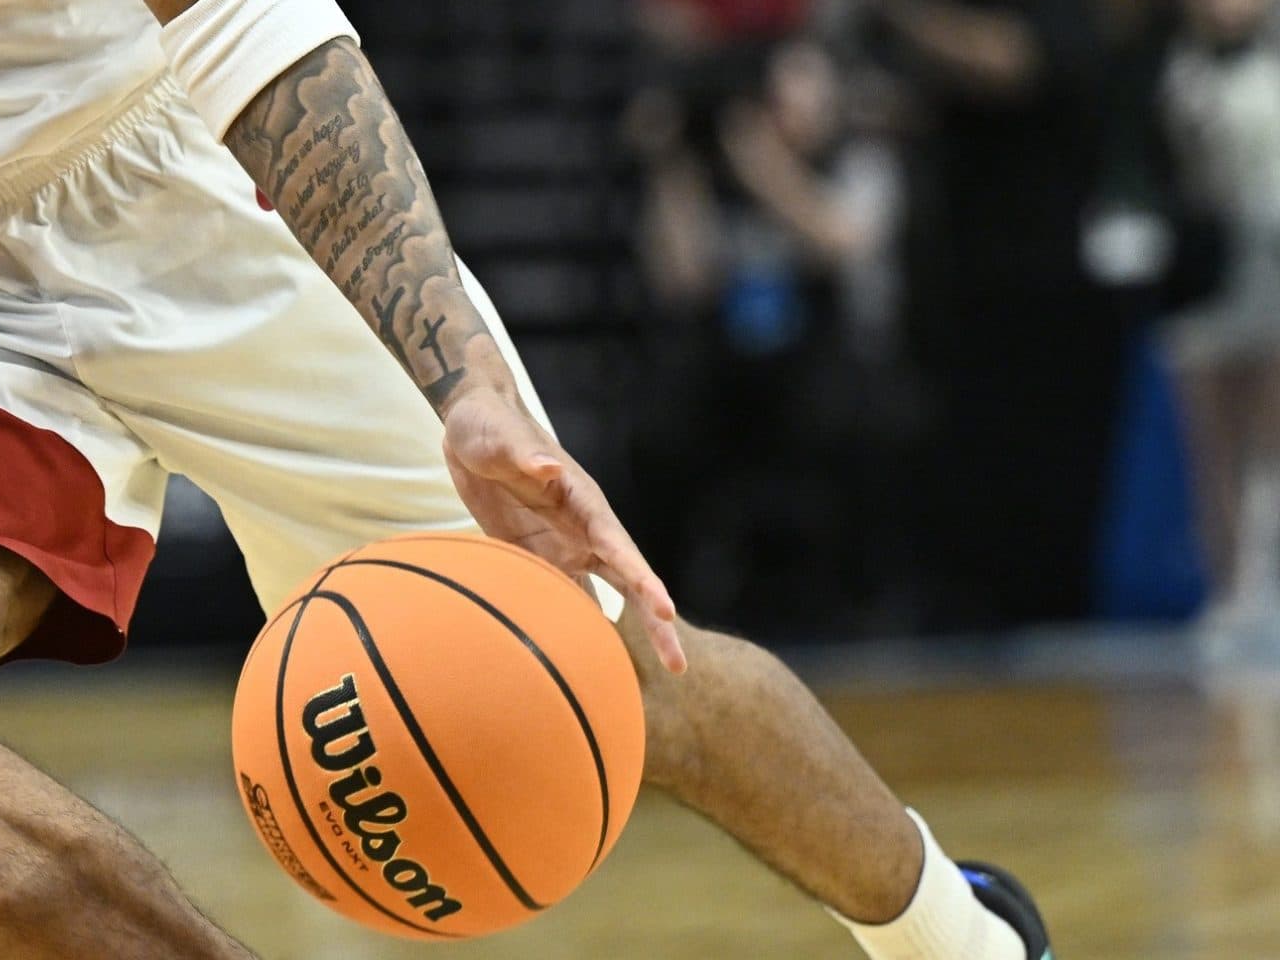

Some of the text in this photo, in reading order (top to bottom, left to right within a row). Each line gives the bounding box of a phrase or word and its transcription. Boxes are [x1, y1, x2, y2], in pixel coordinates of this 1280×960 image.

[301, 672, 463, 923] Wilson
[319, 801, 369, 872] EVO NXT
